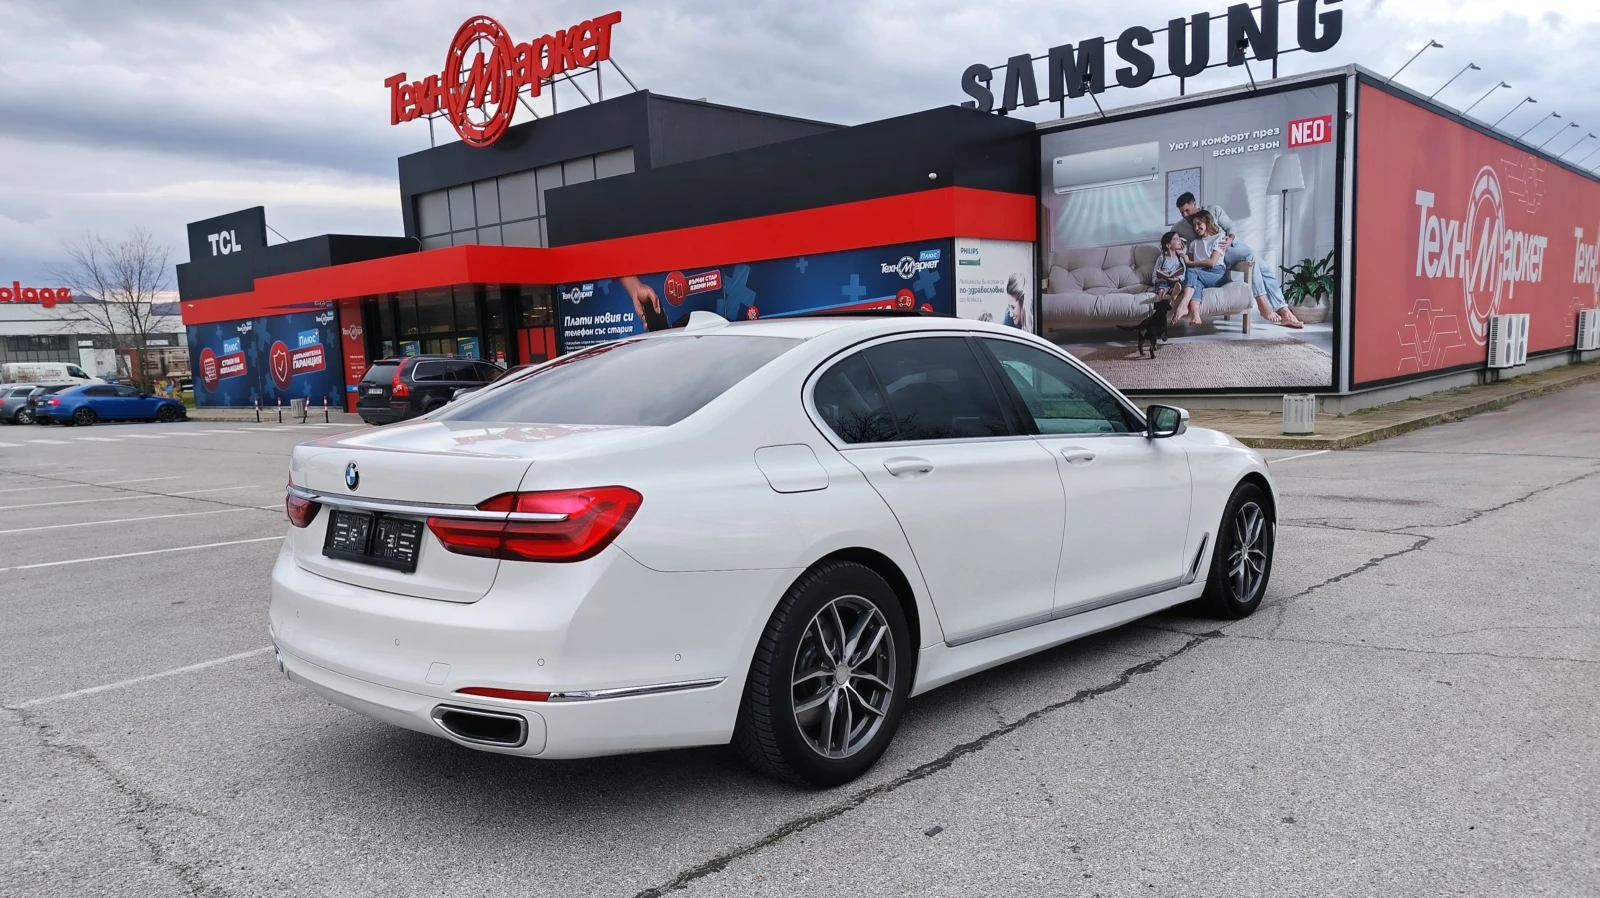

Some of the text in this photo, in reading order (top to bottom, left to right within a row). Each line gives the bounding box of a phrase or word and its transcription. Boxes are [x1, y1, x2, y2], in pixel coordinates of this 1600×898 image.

[961, 0, 1342, 114] SAMSUNG
[1168, 127, 1280, 152] Уют и комфорт през
[1291, 119, 1324, 145] NEO
[1212, 140, 1280, 158] всеки сезон
[208, 229, 242, 257] TCL
[960, 247, 979, 255] PHILIPS
[565, 312, 634, 327] Плати новия си
[564, 327, 594, 338] телефон
[607, 326, 634, 335] стария
